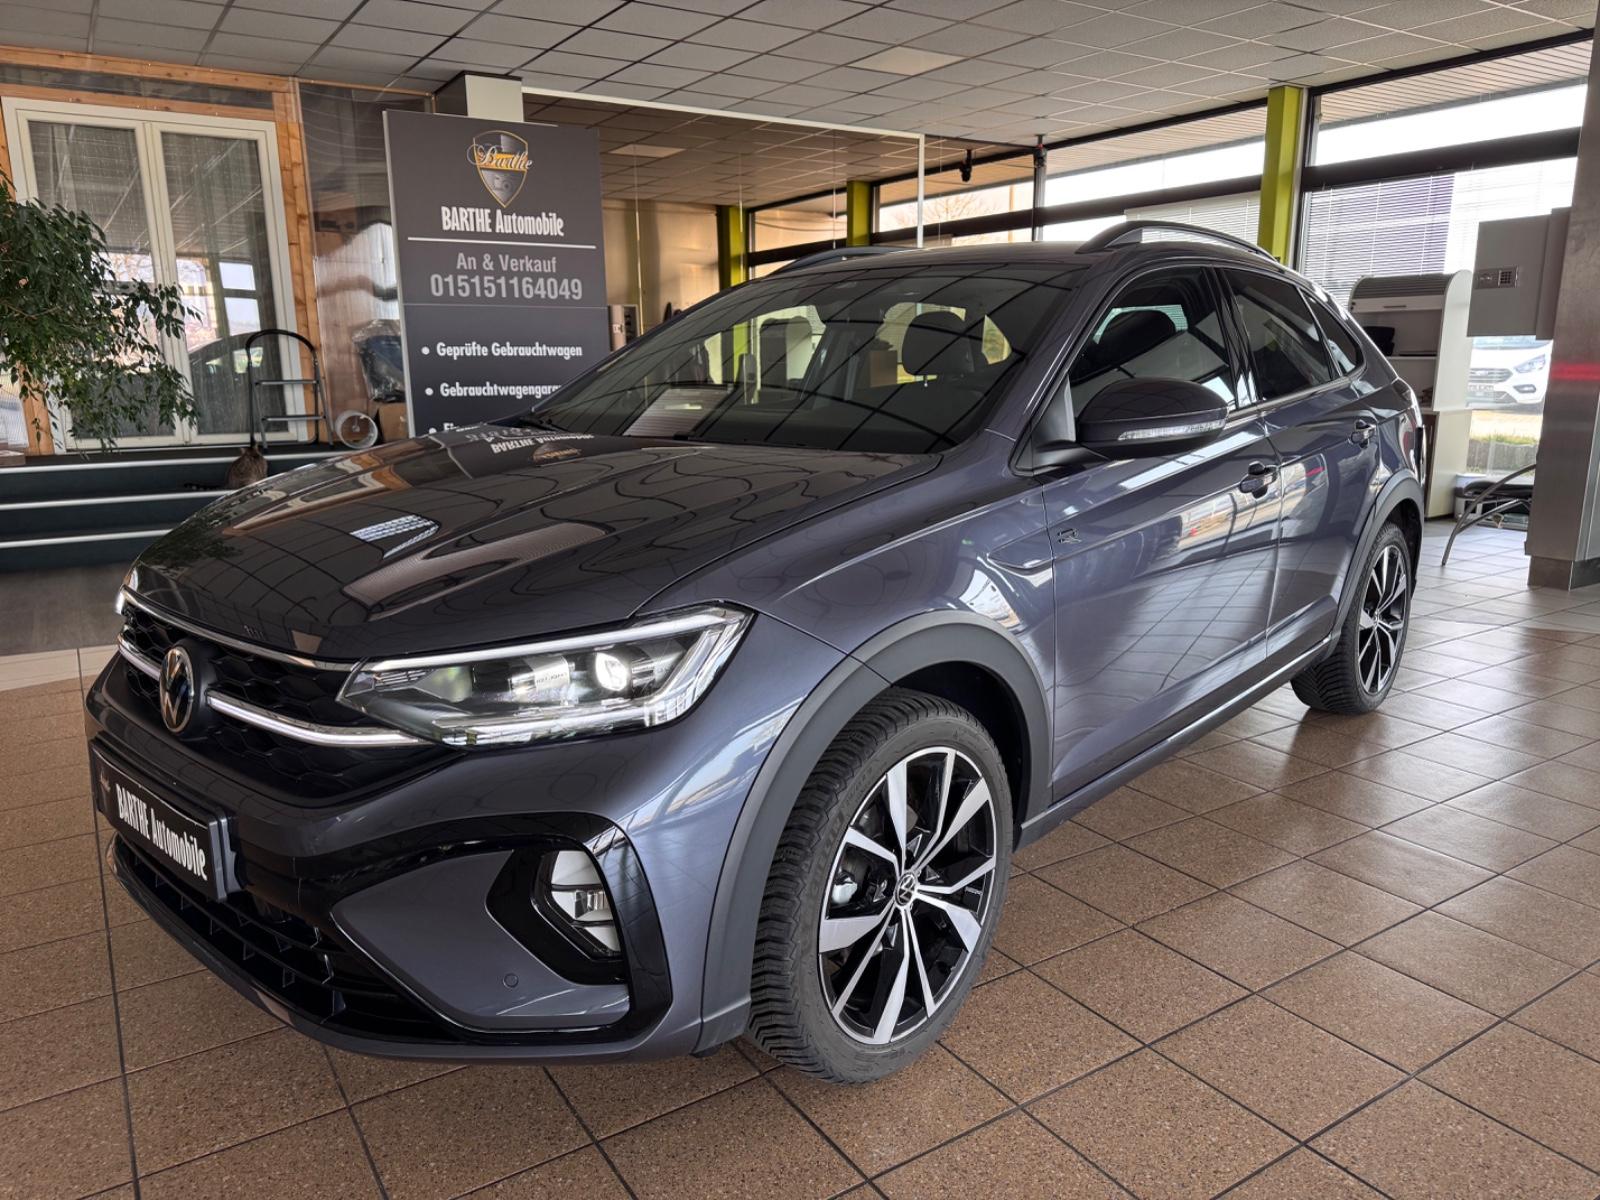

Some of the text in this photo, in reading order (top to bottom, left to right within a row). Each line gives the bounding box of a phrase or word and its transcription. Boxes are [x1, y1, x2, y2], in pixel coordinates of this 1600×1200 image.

[467, 145, 533, 170] Barthe
[441, 206, 564, 236] BARTHE Automobile
[456, 252, 557, 273] An & Verkauf
[430, 273, 583, 300] 015151164049
[436, 341, 582, 361] Geprüfte Gebrauchtwagen
[115, 783, 208, 881] BARTHE Automobile
